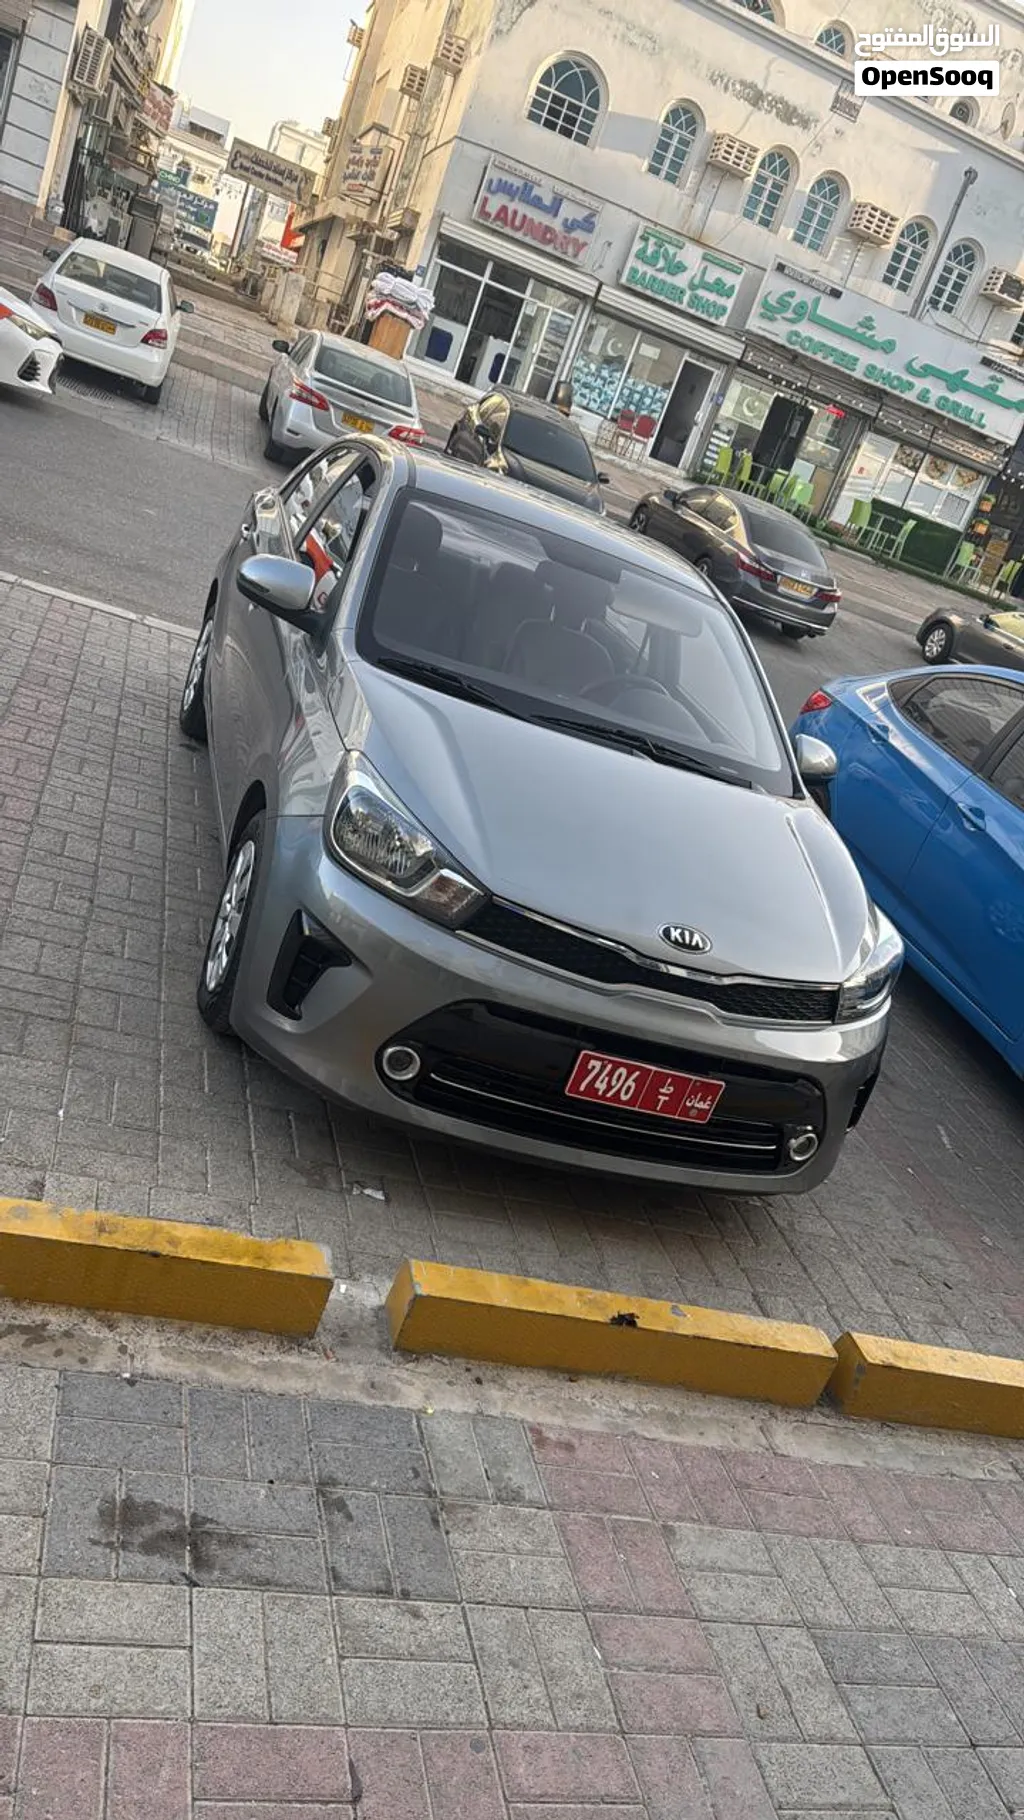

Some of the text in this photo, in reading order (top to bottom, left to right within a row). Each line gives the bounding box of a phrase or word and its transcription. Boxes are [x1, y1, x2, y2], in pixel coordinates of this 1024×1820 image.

[479, 196, 588, 258] LAUNDRY
[635, 234, 688, 276] حلاقة
[626, 266, 728, 320] BARBER SHOP
[688, 265, 735, 299] محل
[786, 330, 986, 429] COFFEE SHOP & GRILL
[670, 927, 703, 948] KIA
[579, 1059, 641, 1101] 7496
[659, 1078, 674, 1094] ط
[656, 1096, 669, 1111] T
